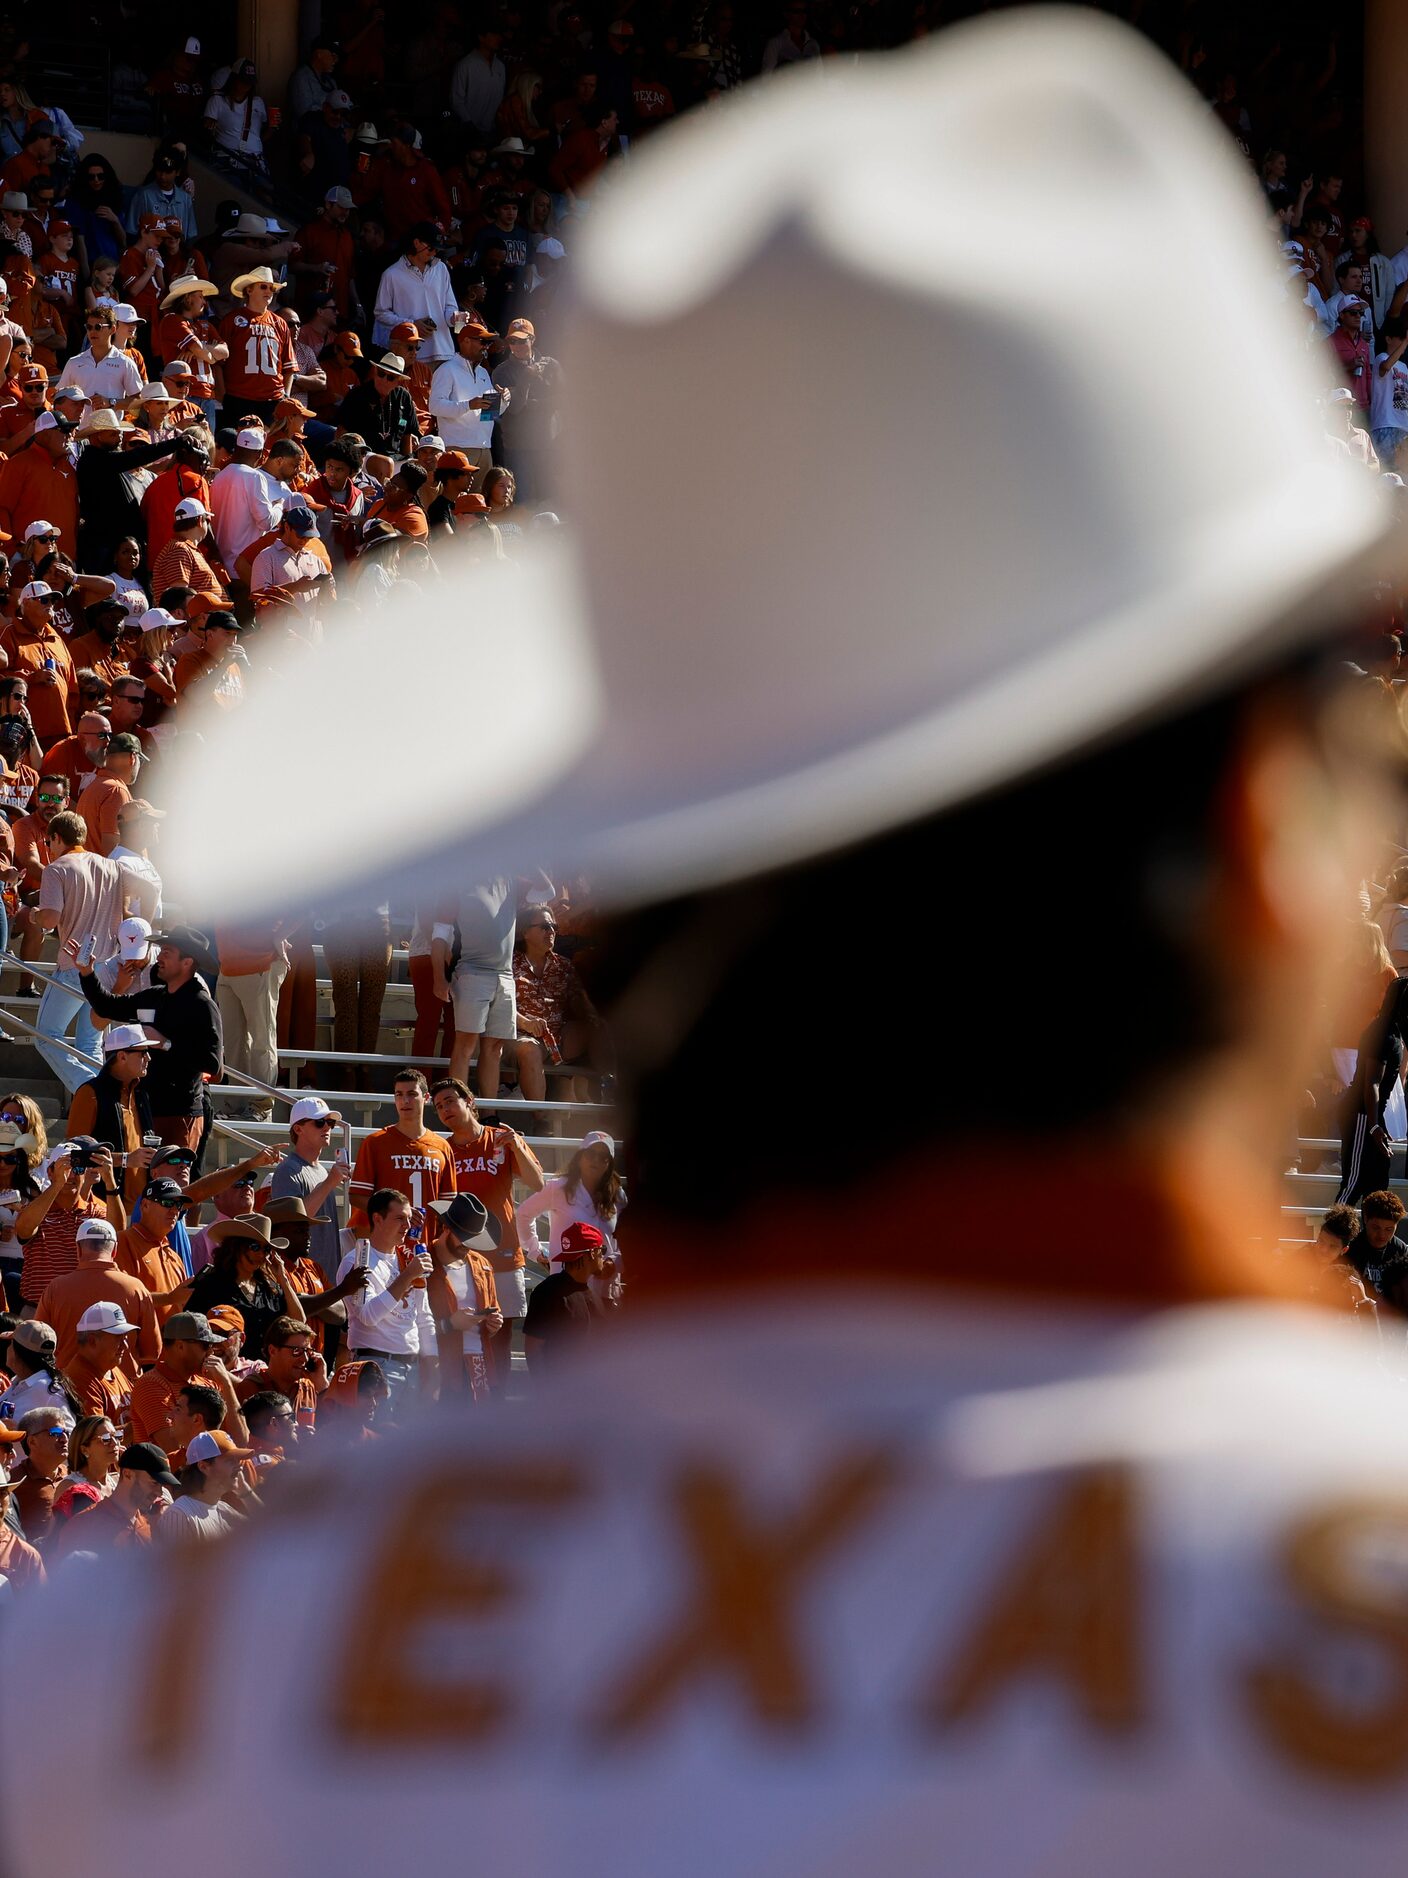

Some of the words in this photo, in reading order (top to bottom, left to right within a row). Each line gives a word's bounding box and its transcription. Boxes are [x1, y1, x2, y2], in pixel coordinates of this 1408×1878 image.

[634, 91, 664, 103] TEXAS
[55, 270, 77, 280] TEXAS
[250, 324, 275, 336] TEXAS
[245, 337, 278, 375] 10
[29, 368, 38, 377] T
[391, 1155, 441, 1172] TEXAS
[455, 1157, 498, 1175] EXAS
[409, 1171, 422, 1208] 1
